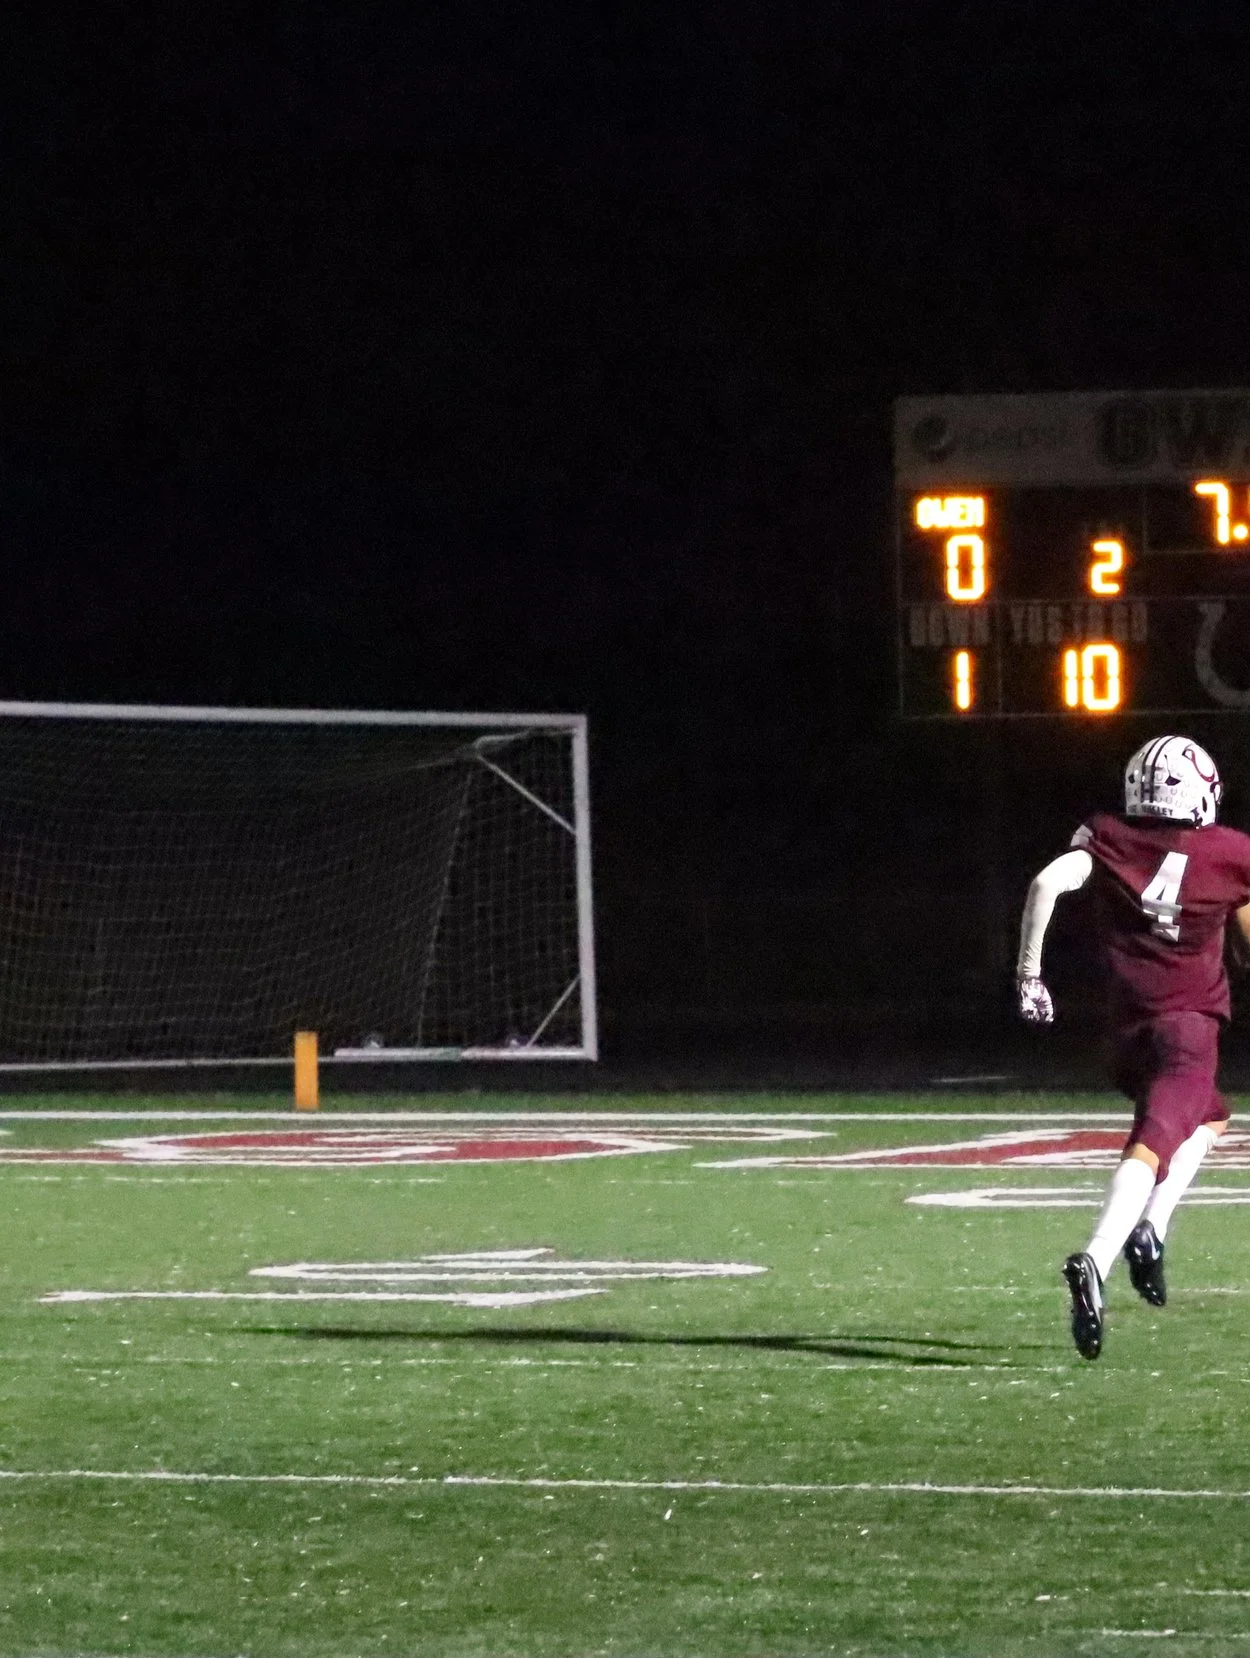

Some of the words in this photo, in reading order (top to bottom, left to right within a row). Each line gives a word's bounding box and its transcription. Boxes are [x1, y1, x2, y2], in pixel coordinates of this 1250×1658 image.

[945, 534, 986, 602] 0
[1090, 539, 1124, 595] 2
[954, 651, 971, 710] 1
[1063, 643, 1121, 712] 10
[1141, 851, 1188, 942] 4
